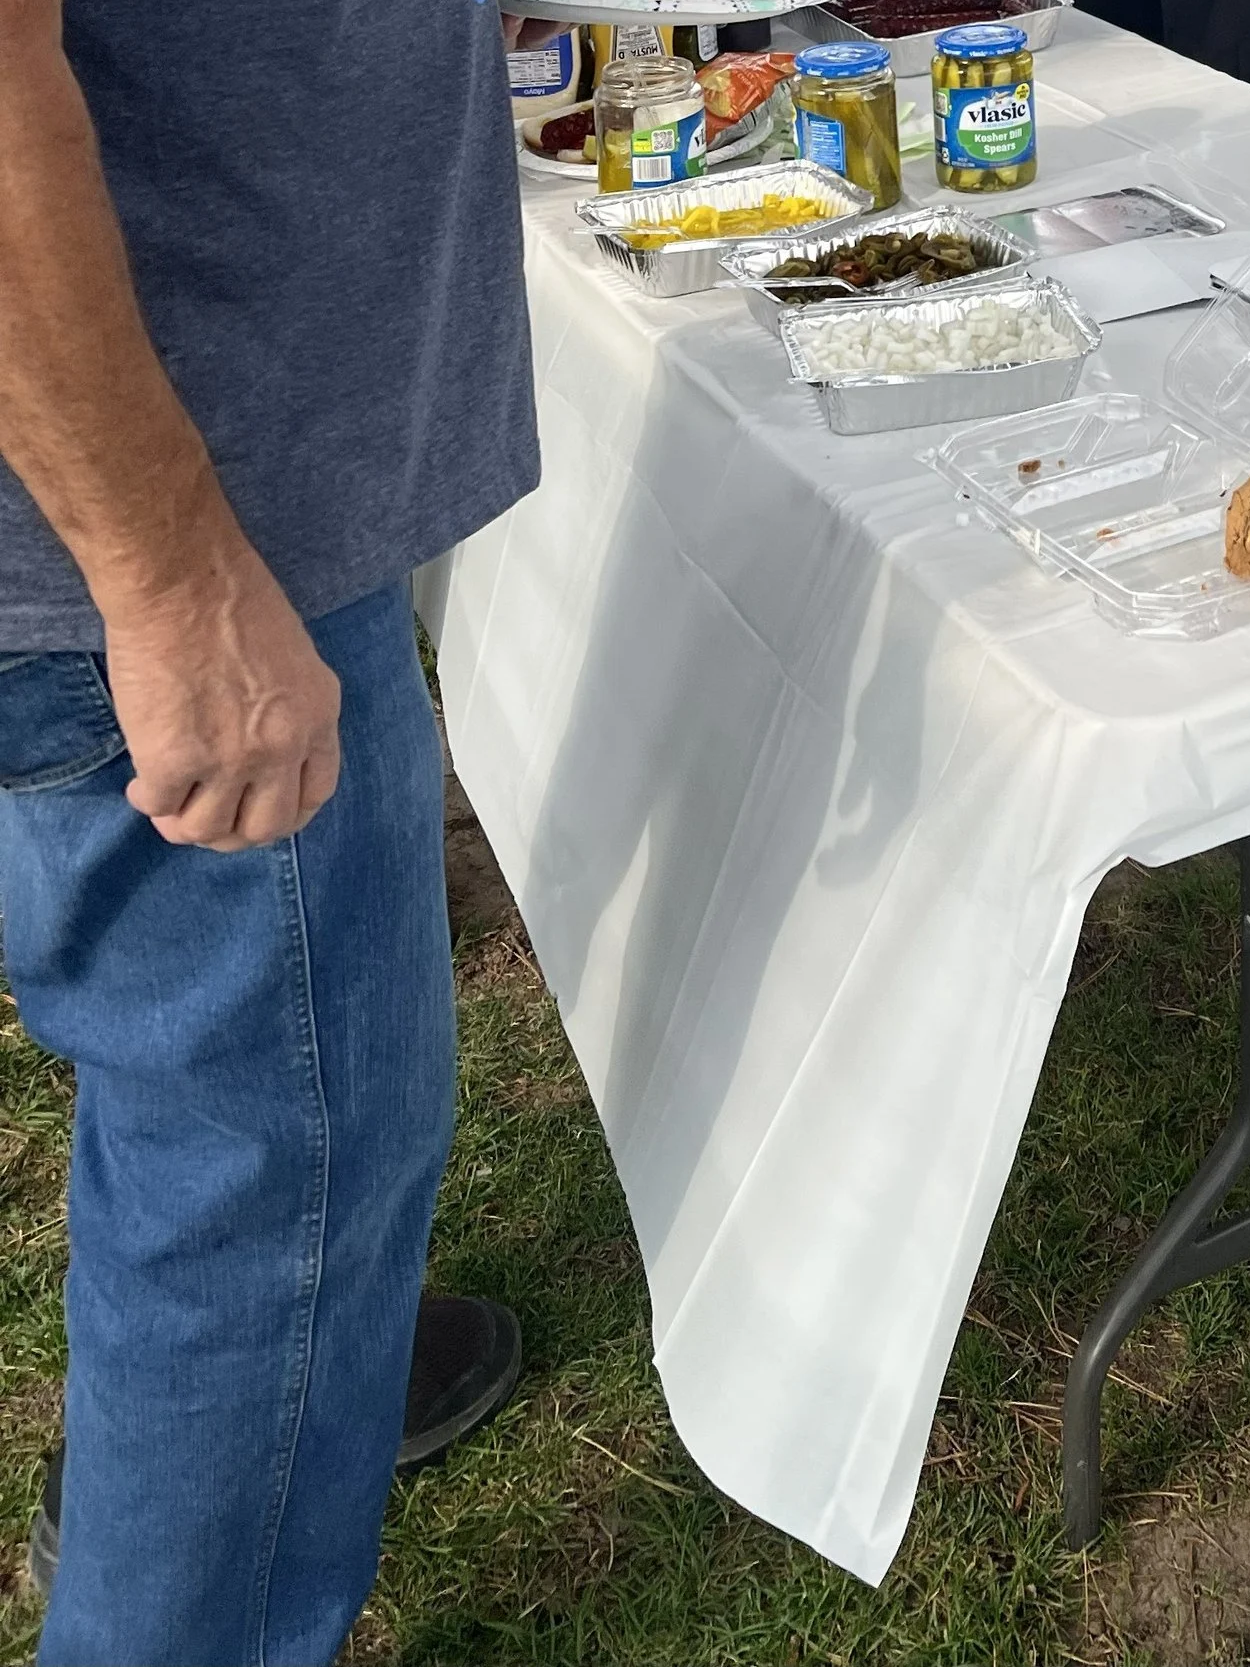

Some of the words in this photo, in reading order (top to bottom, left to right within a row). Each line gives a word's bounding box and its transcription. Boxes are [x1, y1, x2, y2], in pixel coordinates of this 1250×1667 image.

[618, 46, 658, 59] MUSTAD
[968, 102, 1026, 123] vlasic
[974, 132, 1008, 144] Kosher
[1009, 128, 1022, 140] Dill
[984, 142, 1016, 156] Spears
